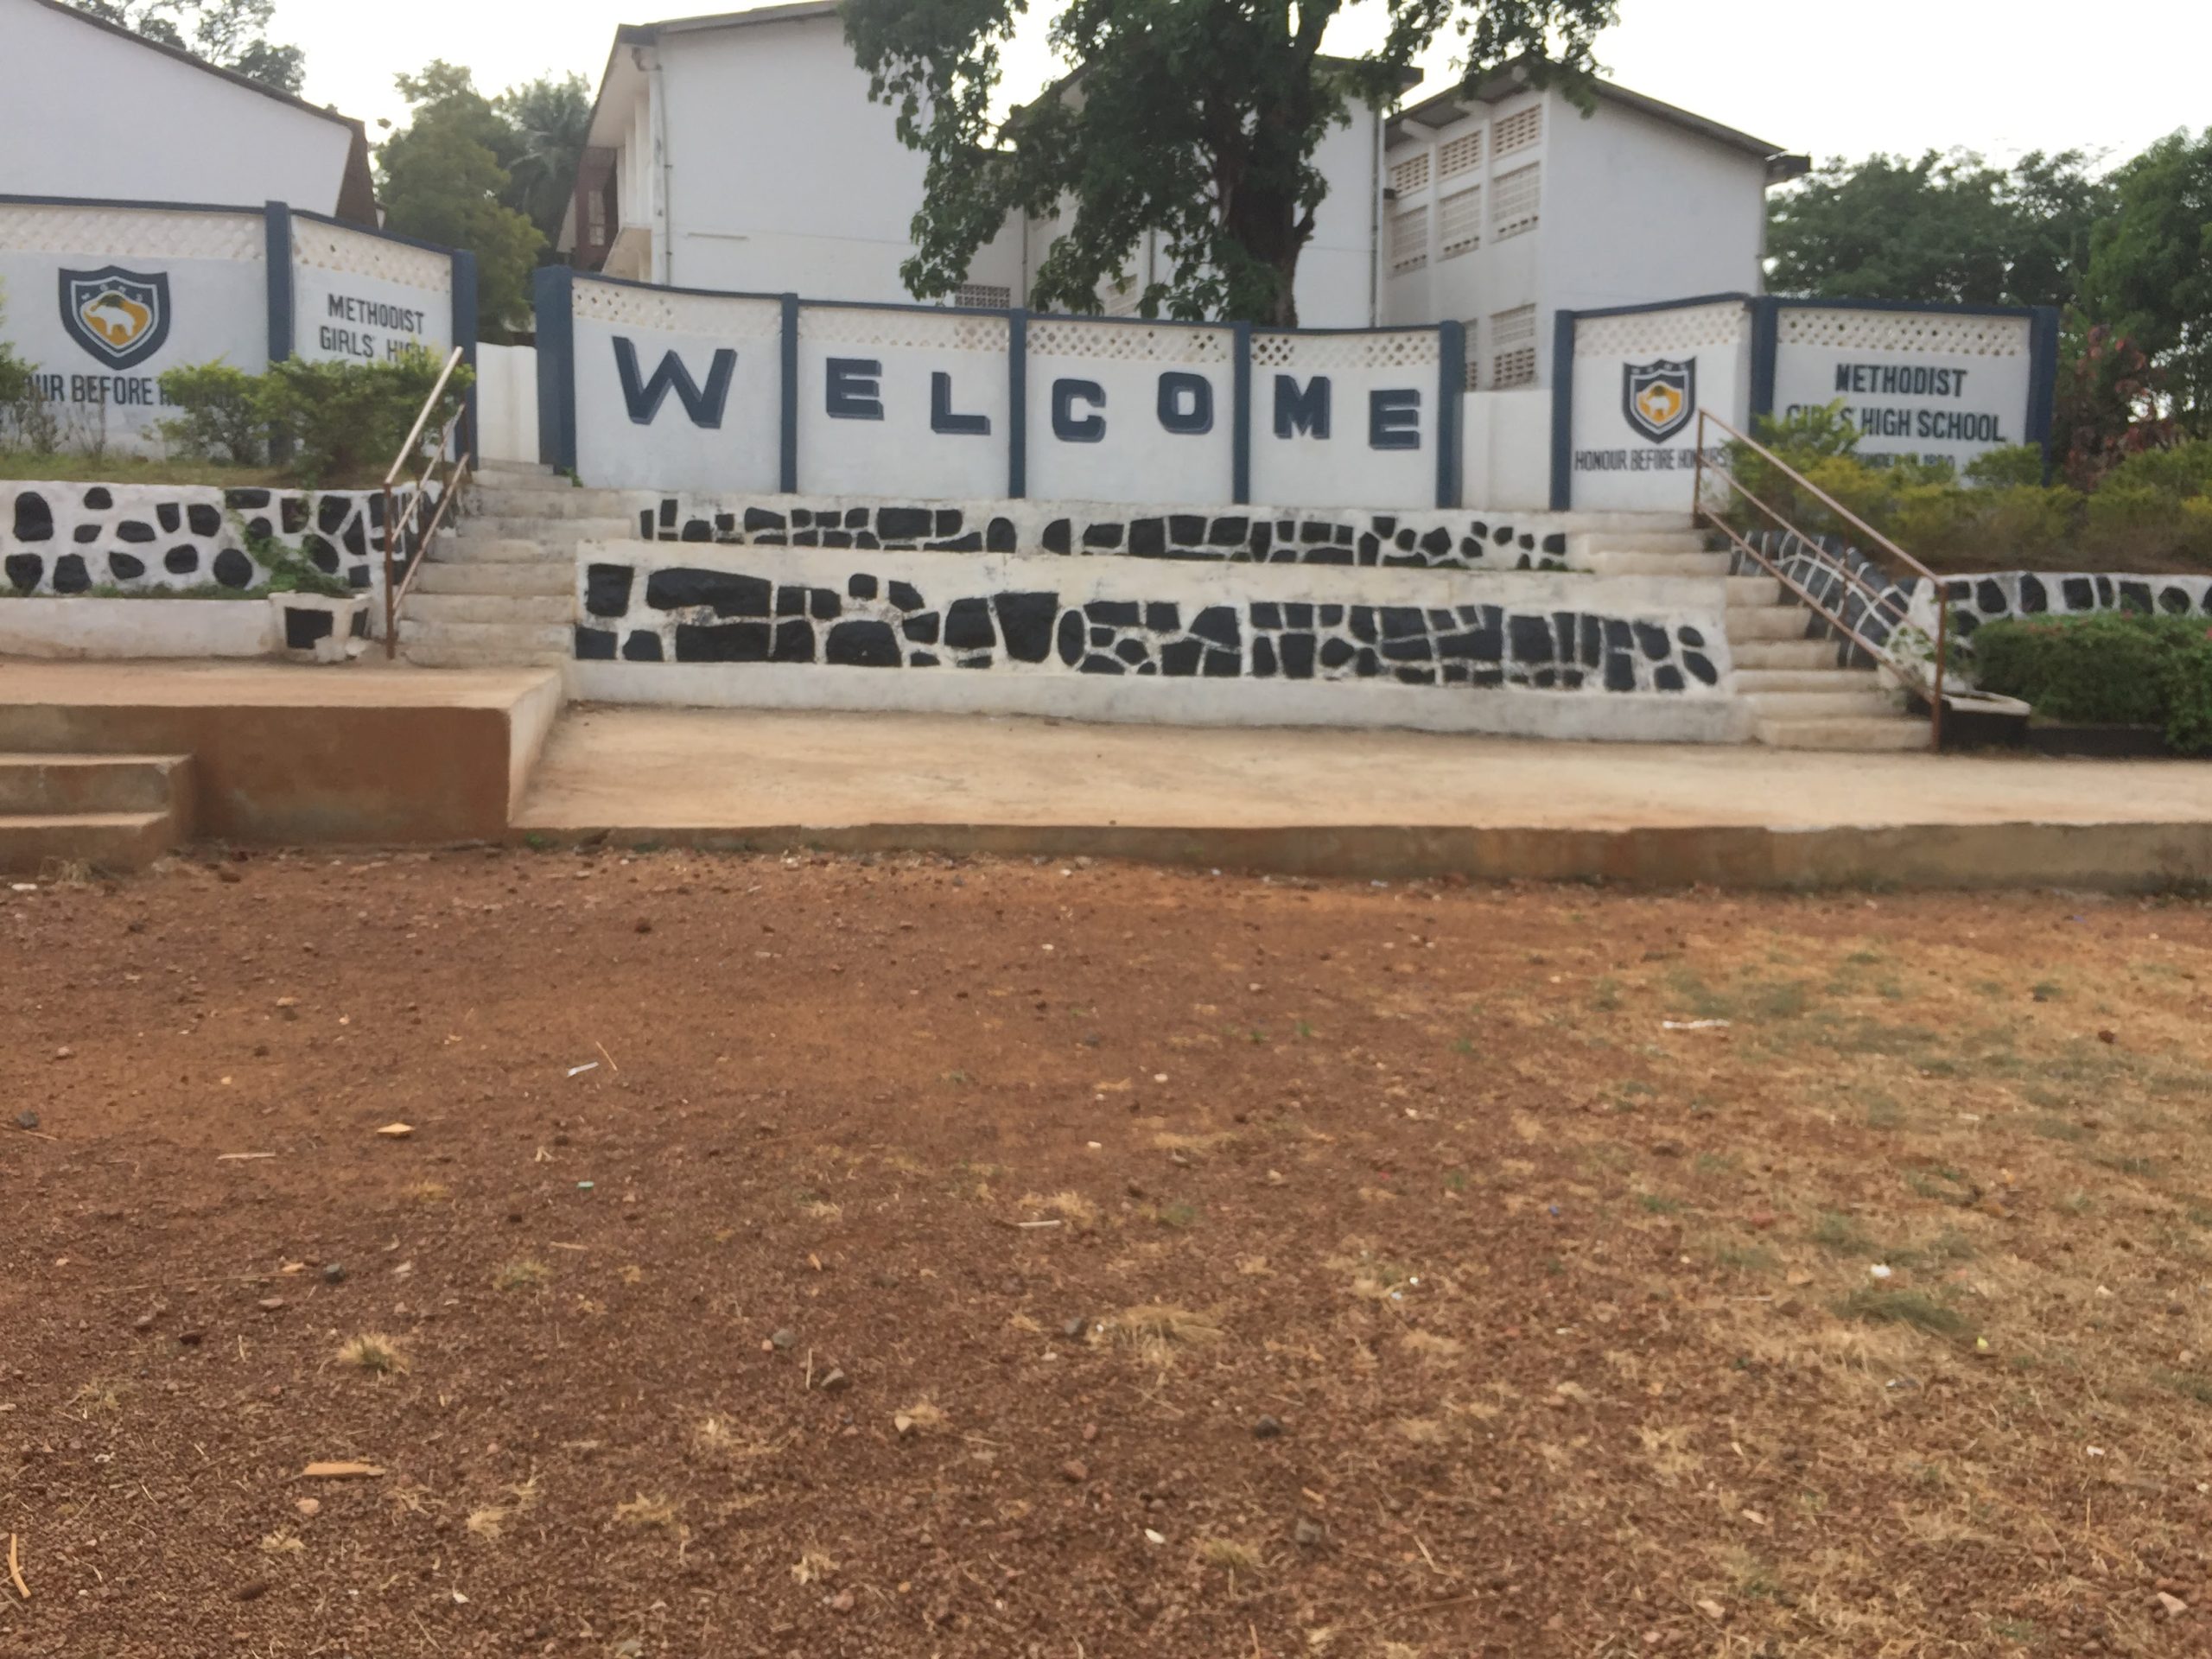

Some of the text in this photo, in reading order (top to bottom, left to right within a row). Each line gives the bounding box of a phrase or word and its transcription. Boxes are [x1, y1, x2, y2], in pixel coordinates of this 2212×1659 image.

[328, 293, 424, 335] METHODIST
[72, 374, 154, 406] BEFORE
[611, 335, 1421, 450] WELCOME
[1835, 363, 1967, 397] METHODIST
[1861, 407, 1911, 437] HIGH
[1917, 409, 2006, 443] SCHOOL
[1574, 448, 1628, 472] HONOUR
[1630, 448, 1675, 471] BEFORE
